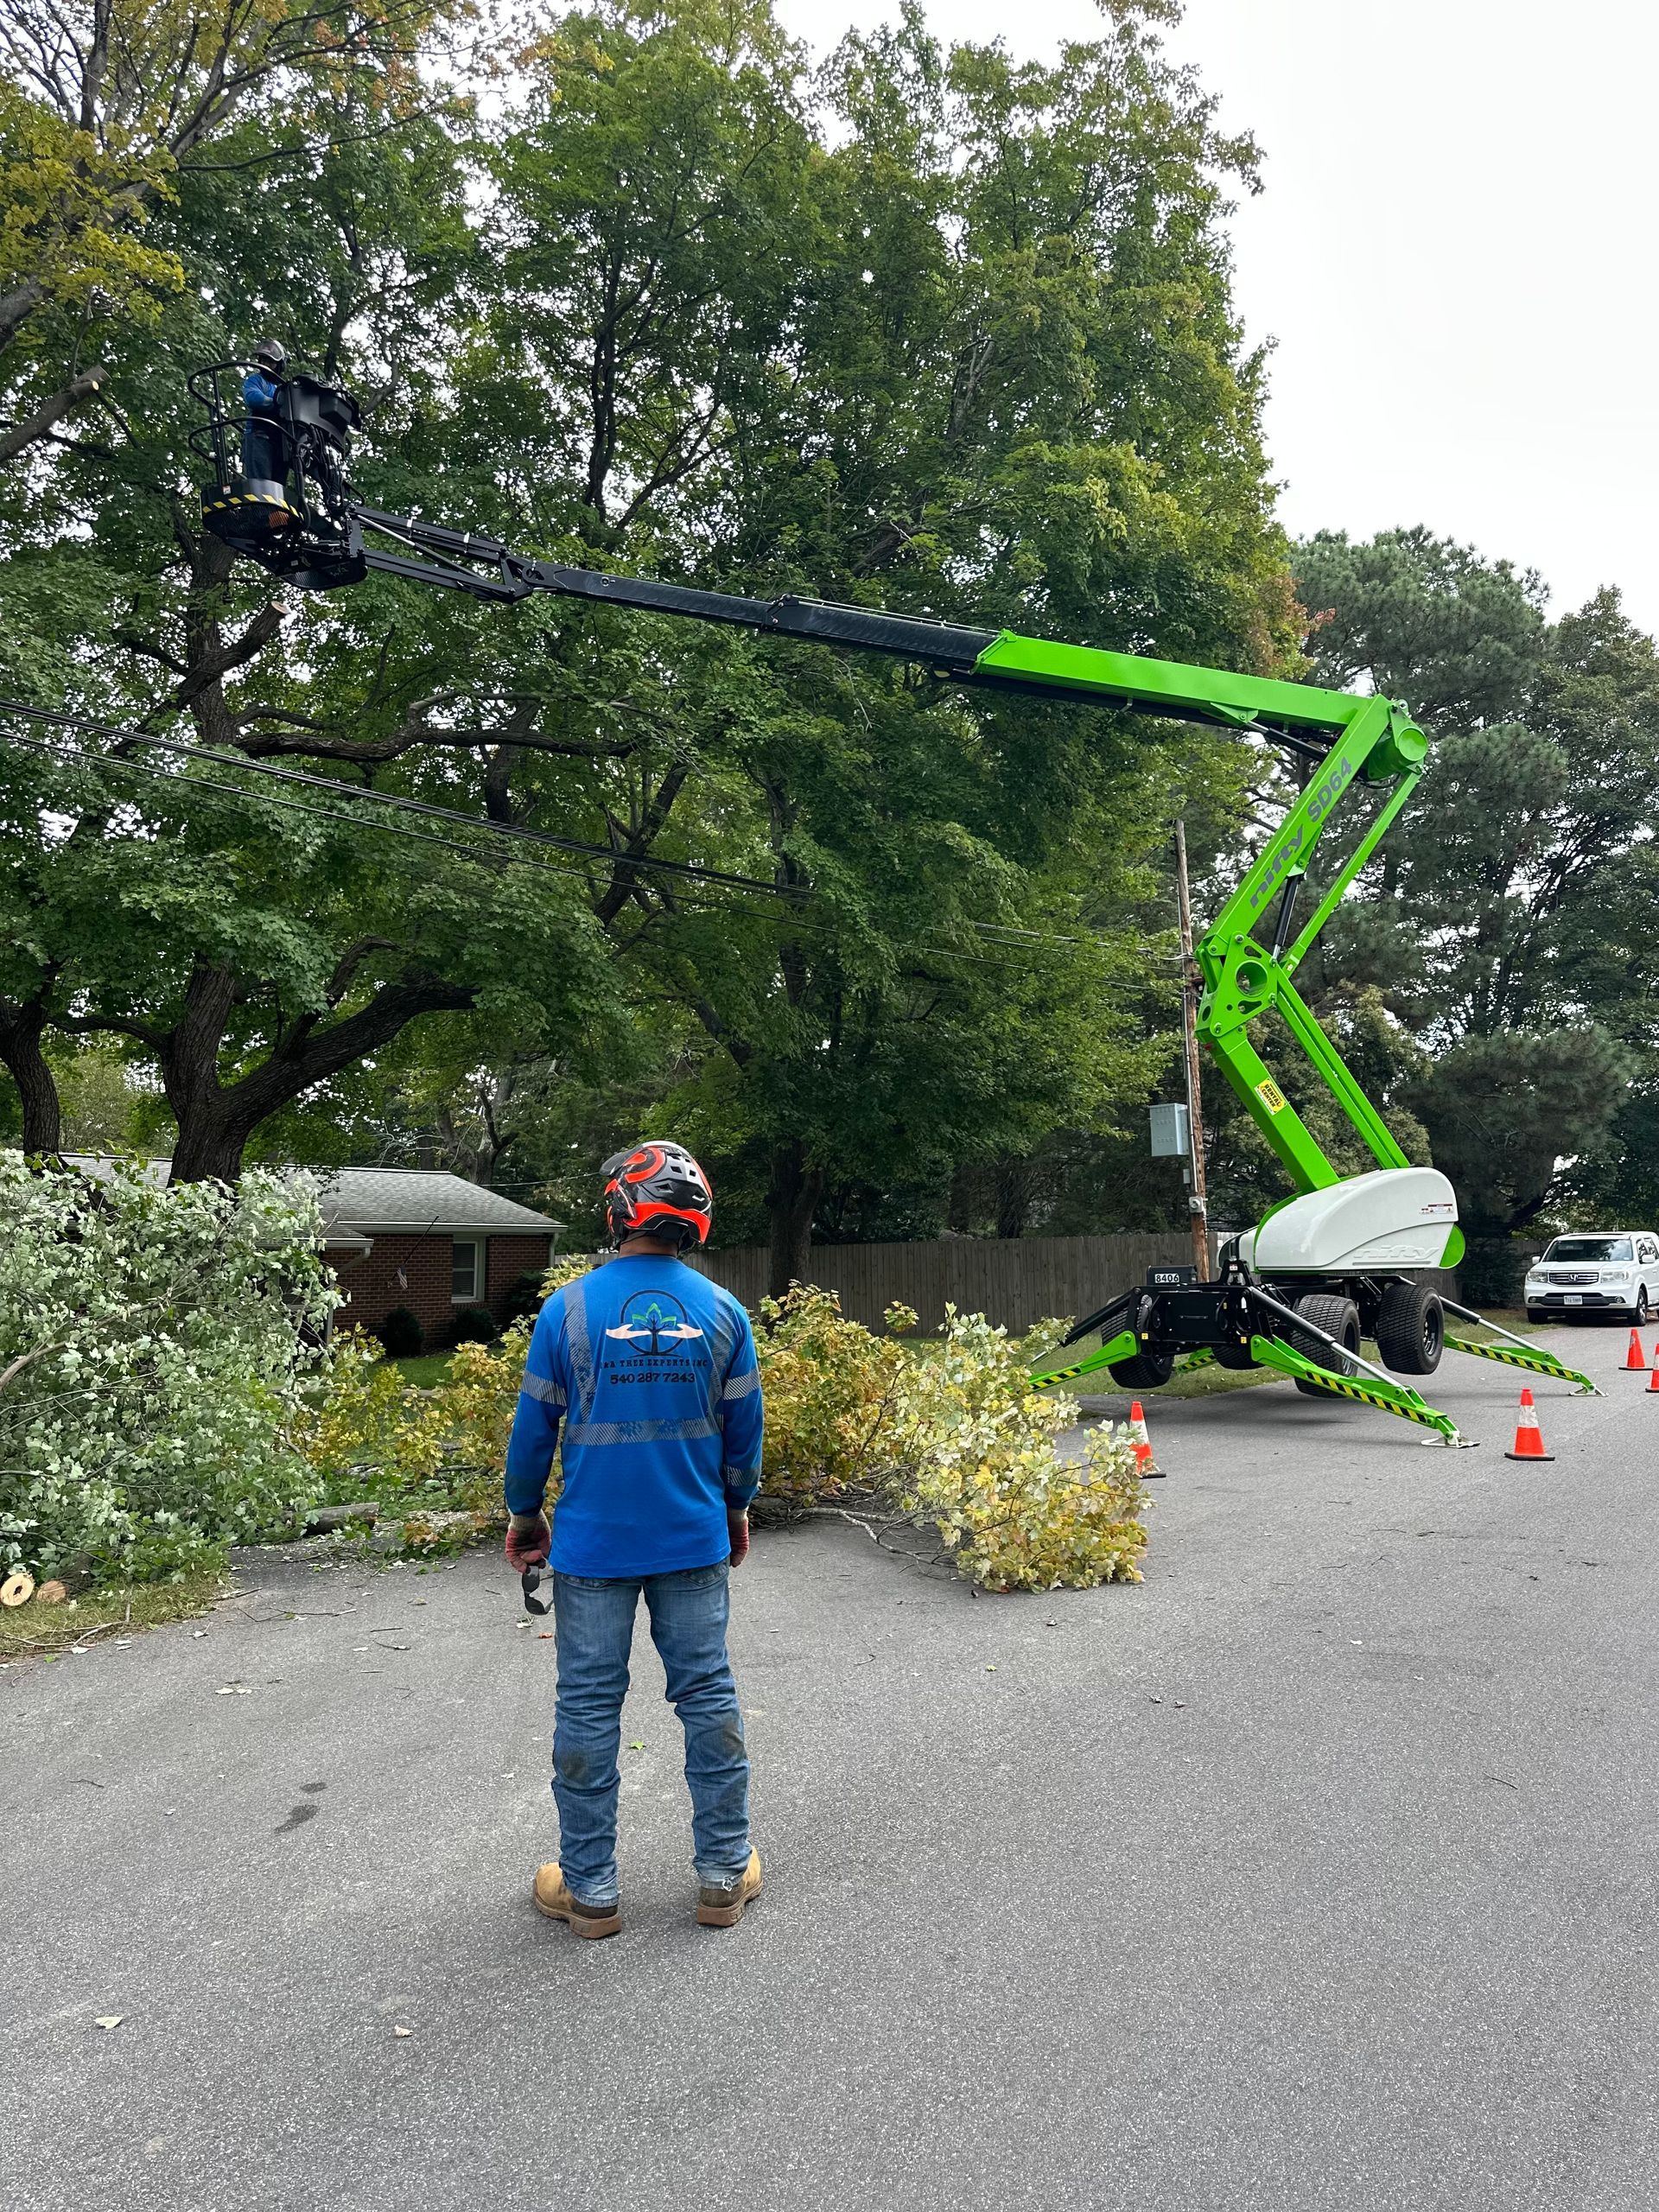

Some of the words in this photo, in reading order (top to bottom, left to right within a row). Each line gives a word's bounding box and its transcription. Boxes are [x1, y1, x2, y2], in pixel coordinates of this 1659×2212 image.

[1249, 823, 1304, 908] nifty
[1307, 756, 1352, 823] SD64
[1262, 1089, 1275, 1107] CENTER
[1265, 1084, 1281, 1106] RENTAL
[1353, 1244, 1440, 1261] nifty
[1155, 1274, 1179, 1282] 8406
[647, 1358, 690, 1367] EXPERTS
[692, 1358, 708, 1367] INC
[610, 1373, 636, 1385] 540
[637, 1372, 660, 1383] 287
[663, 1372, 696, 1383] 7243
